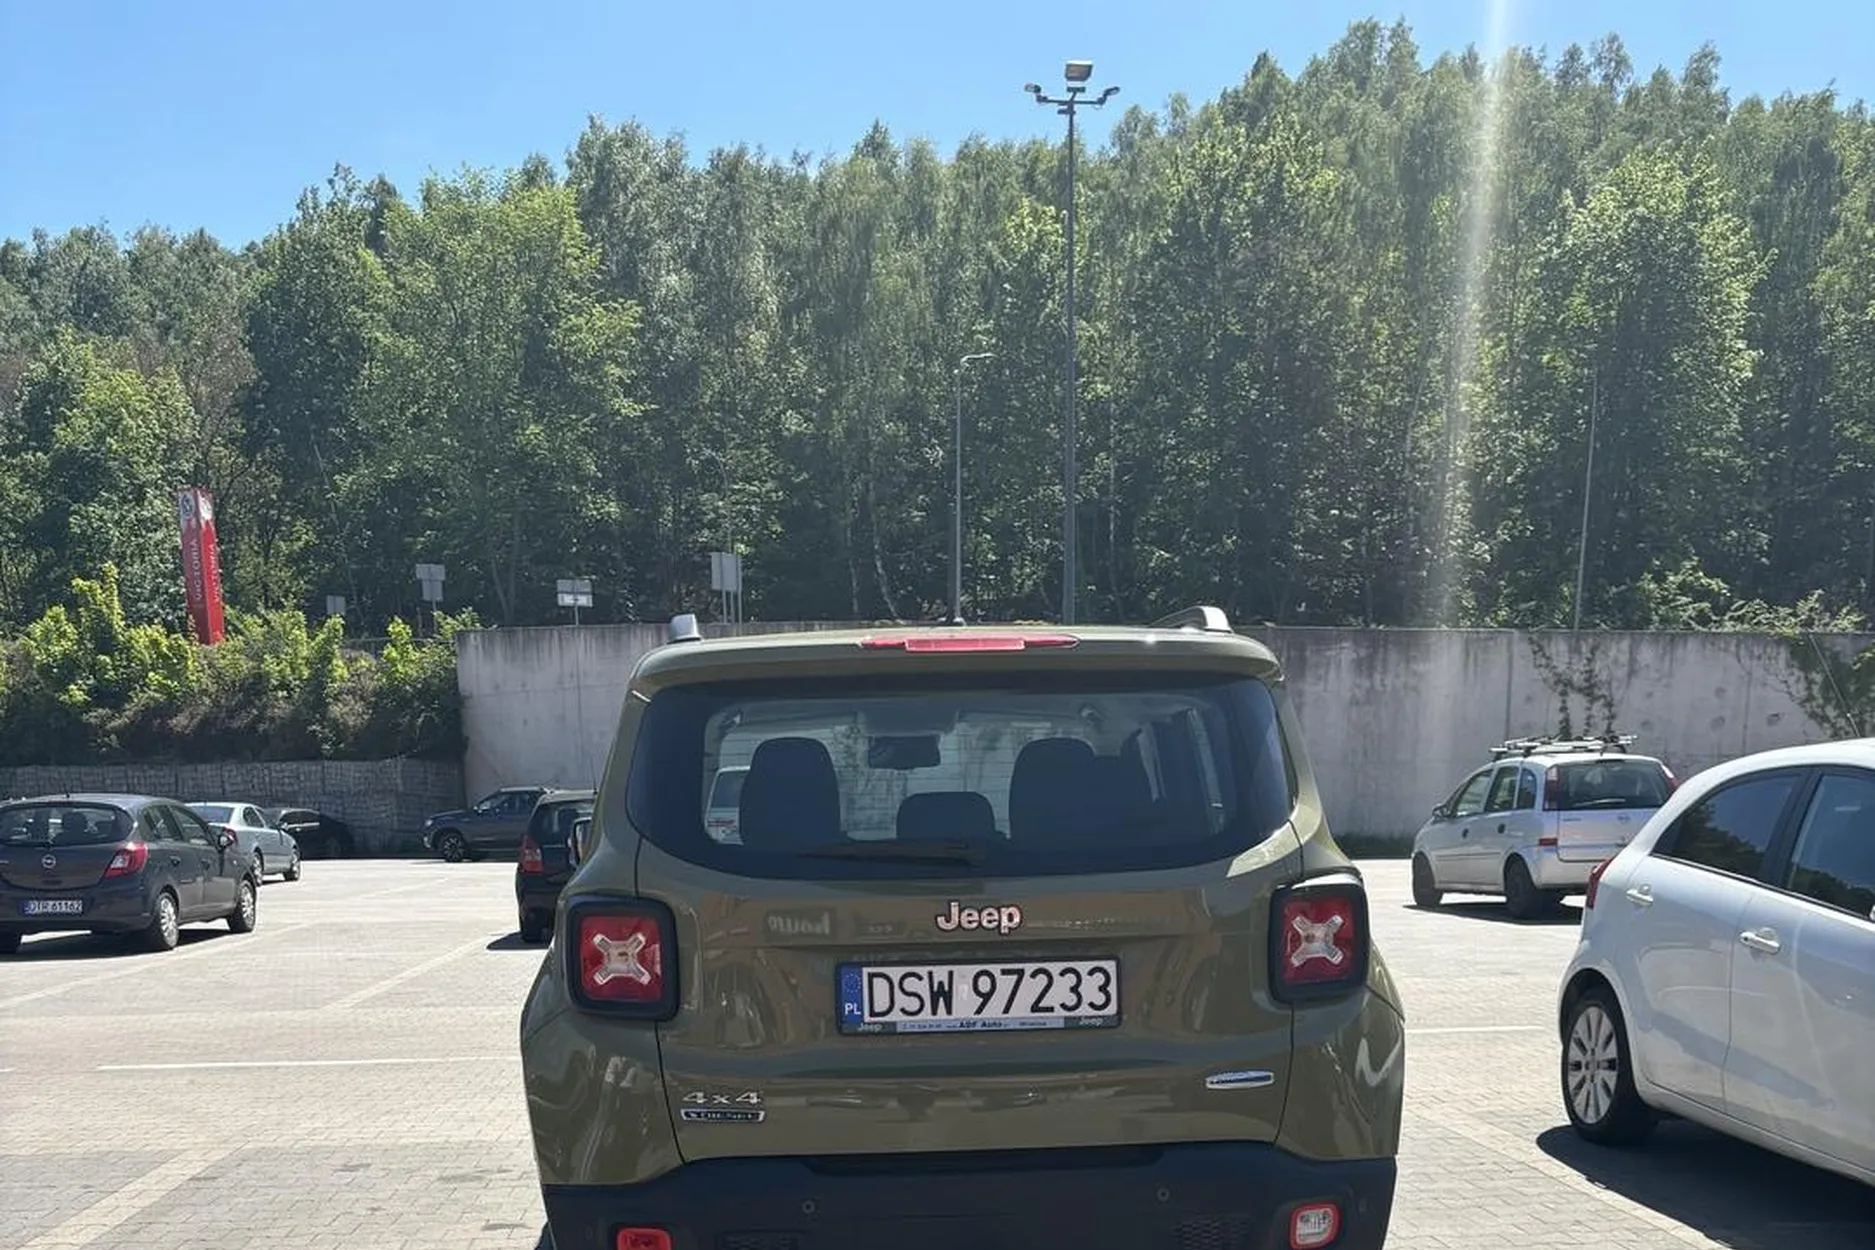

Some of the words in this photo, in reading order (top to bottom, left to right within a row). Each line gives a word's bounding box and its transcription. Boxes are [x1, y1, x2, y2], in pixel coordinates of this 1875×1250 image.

[936, 901, 1021, 934] Jeep
[867, 970, 954, 1018] DSW
[972, 966, 1112, 1016] 97233
[844, 1003, 862, 1015] PL
[1079, 1016, 1103, 1026] Jeep
[857, 1023, 882, 1033] Jeep
[682, 1092, 762, 1104] 4x4
